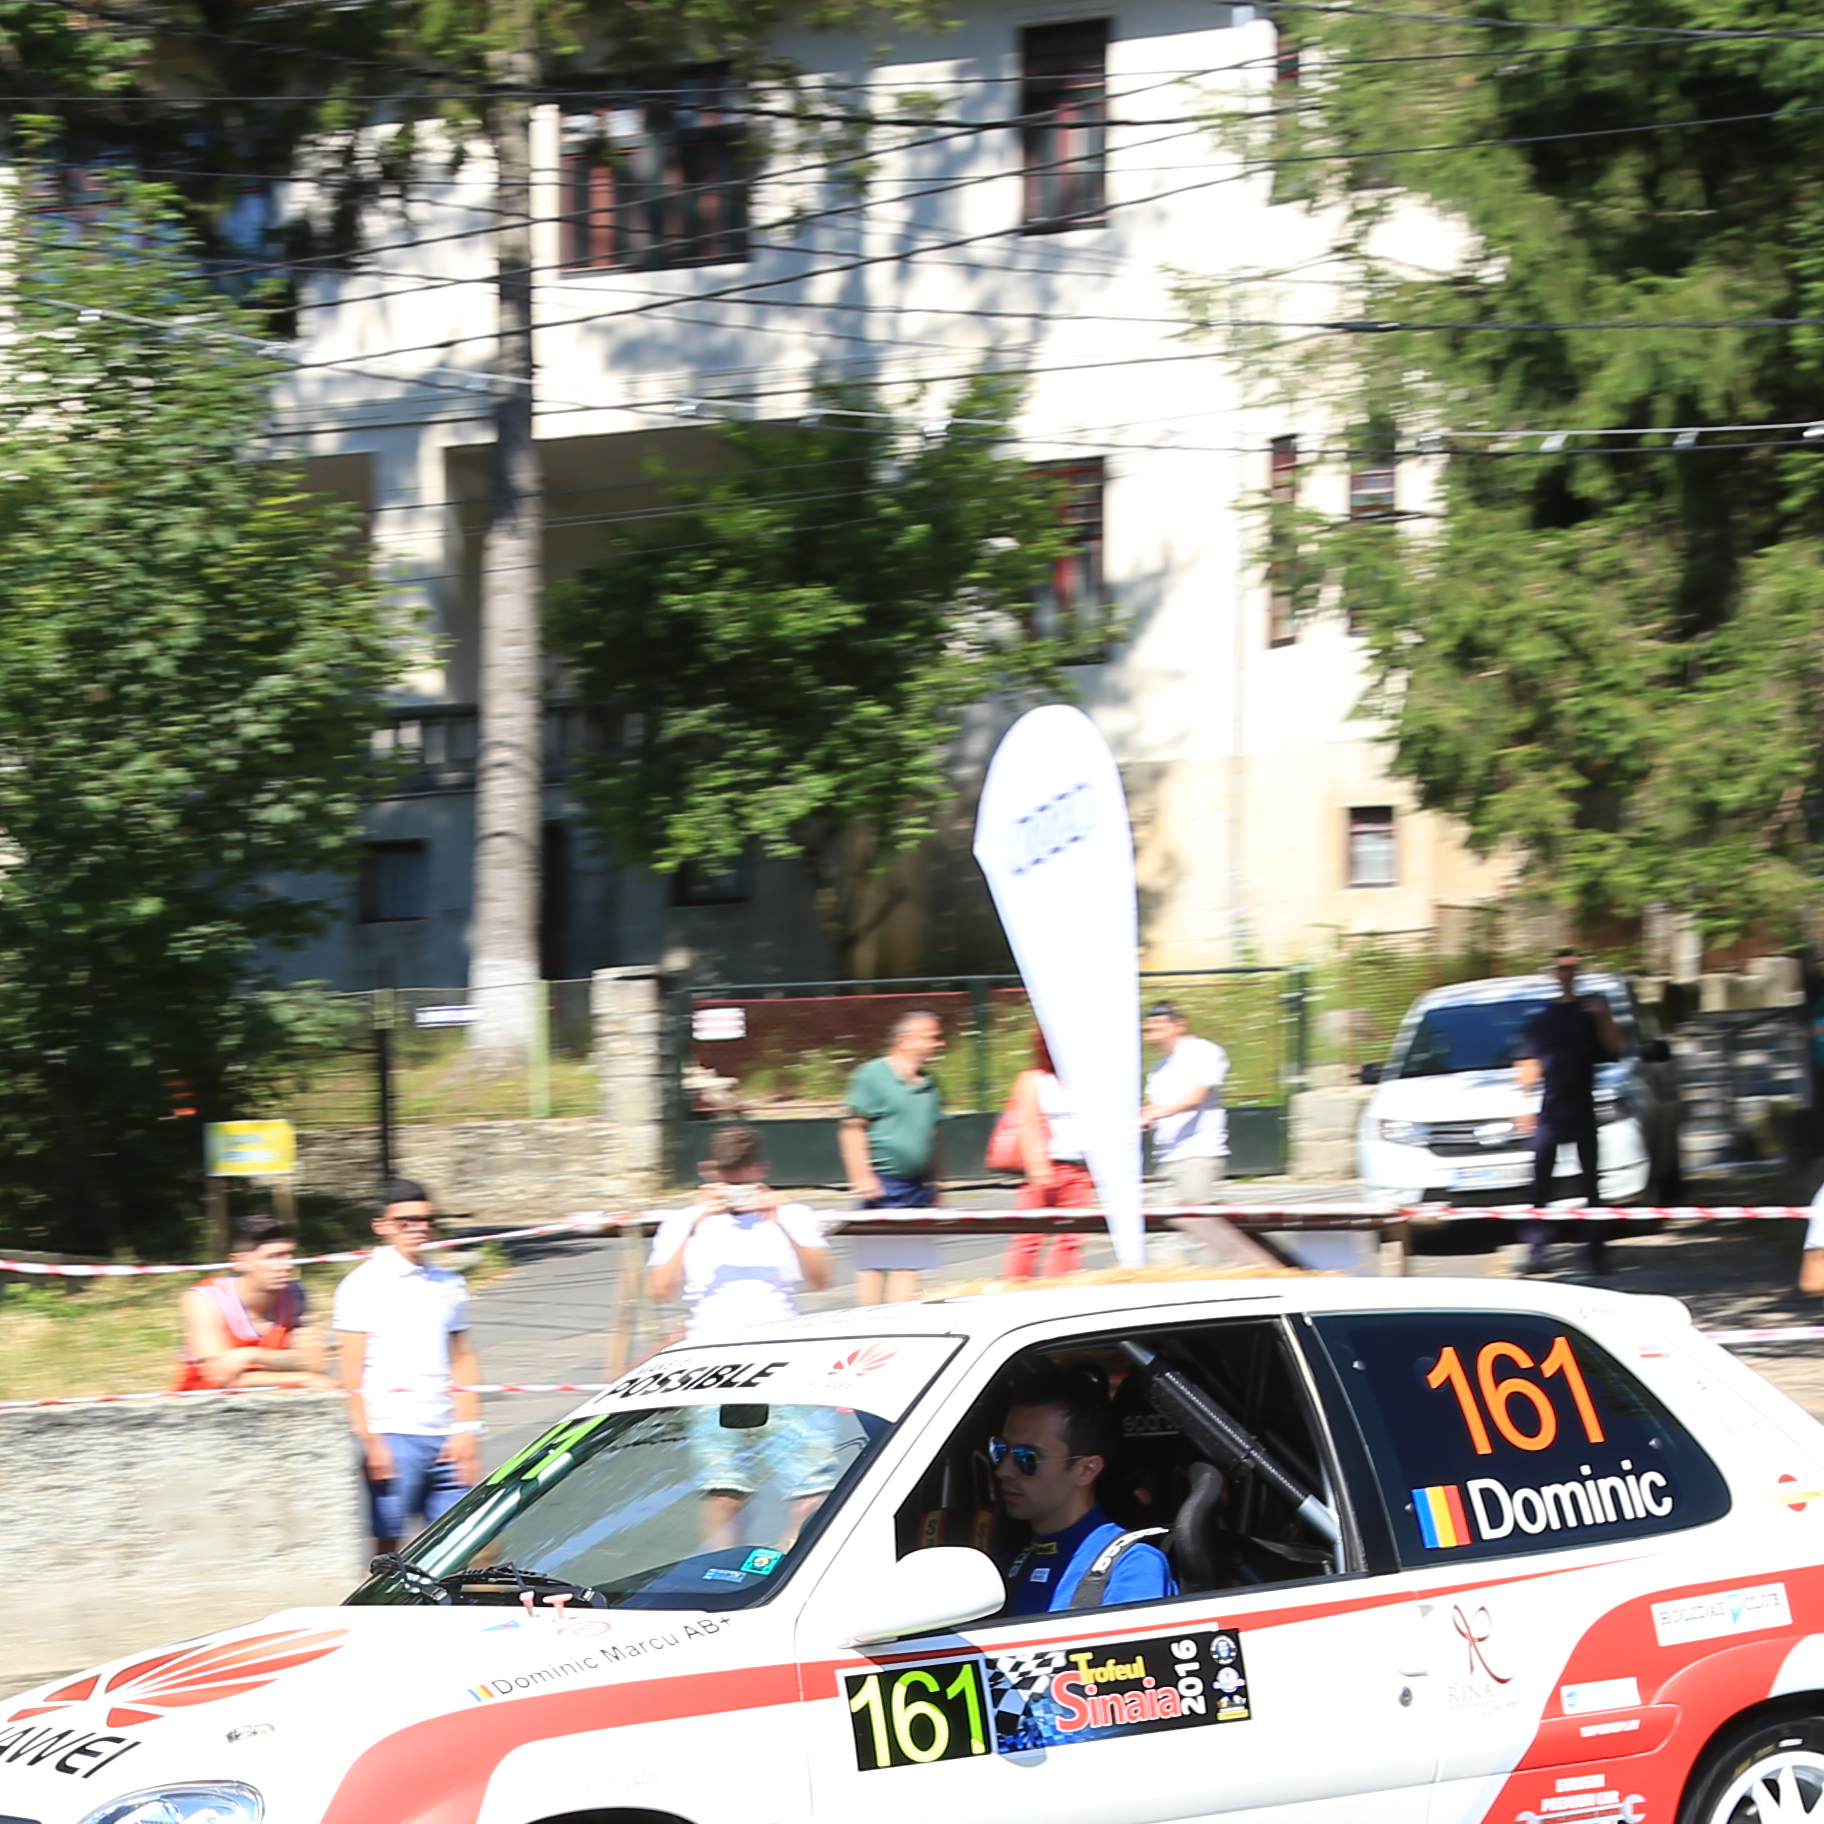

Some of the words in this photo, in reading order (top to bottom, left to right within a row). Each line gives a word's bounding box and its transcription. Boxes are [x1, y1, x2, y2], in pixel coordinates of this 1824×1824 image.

[592, 1361, 791, 1405] POSSIBLE
[1426, 1335, 1606, 1455] 161
[1466, 1459, 1674, 1541] Dominic
[491, 1656, 599, 1696] Dominic
[600, 1632, 681, 1664] Marcu
[684, 1616, 732, 1640] AB+
[1068, 1651, 1147, 1685] Trofeul
[1170, 1638, 1208, 1716] 2016
[848, 1663, 988, 1768] 161
[1051, 1671, 1183, 1733] Sinaia
